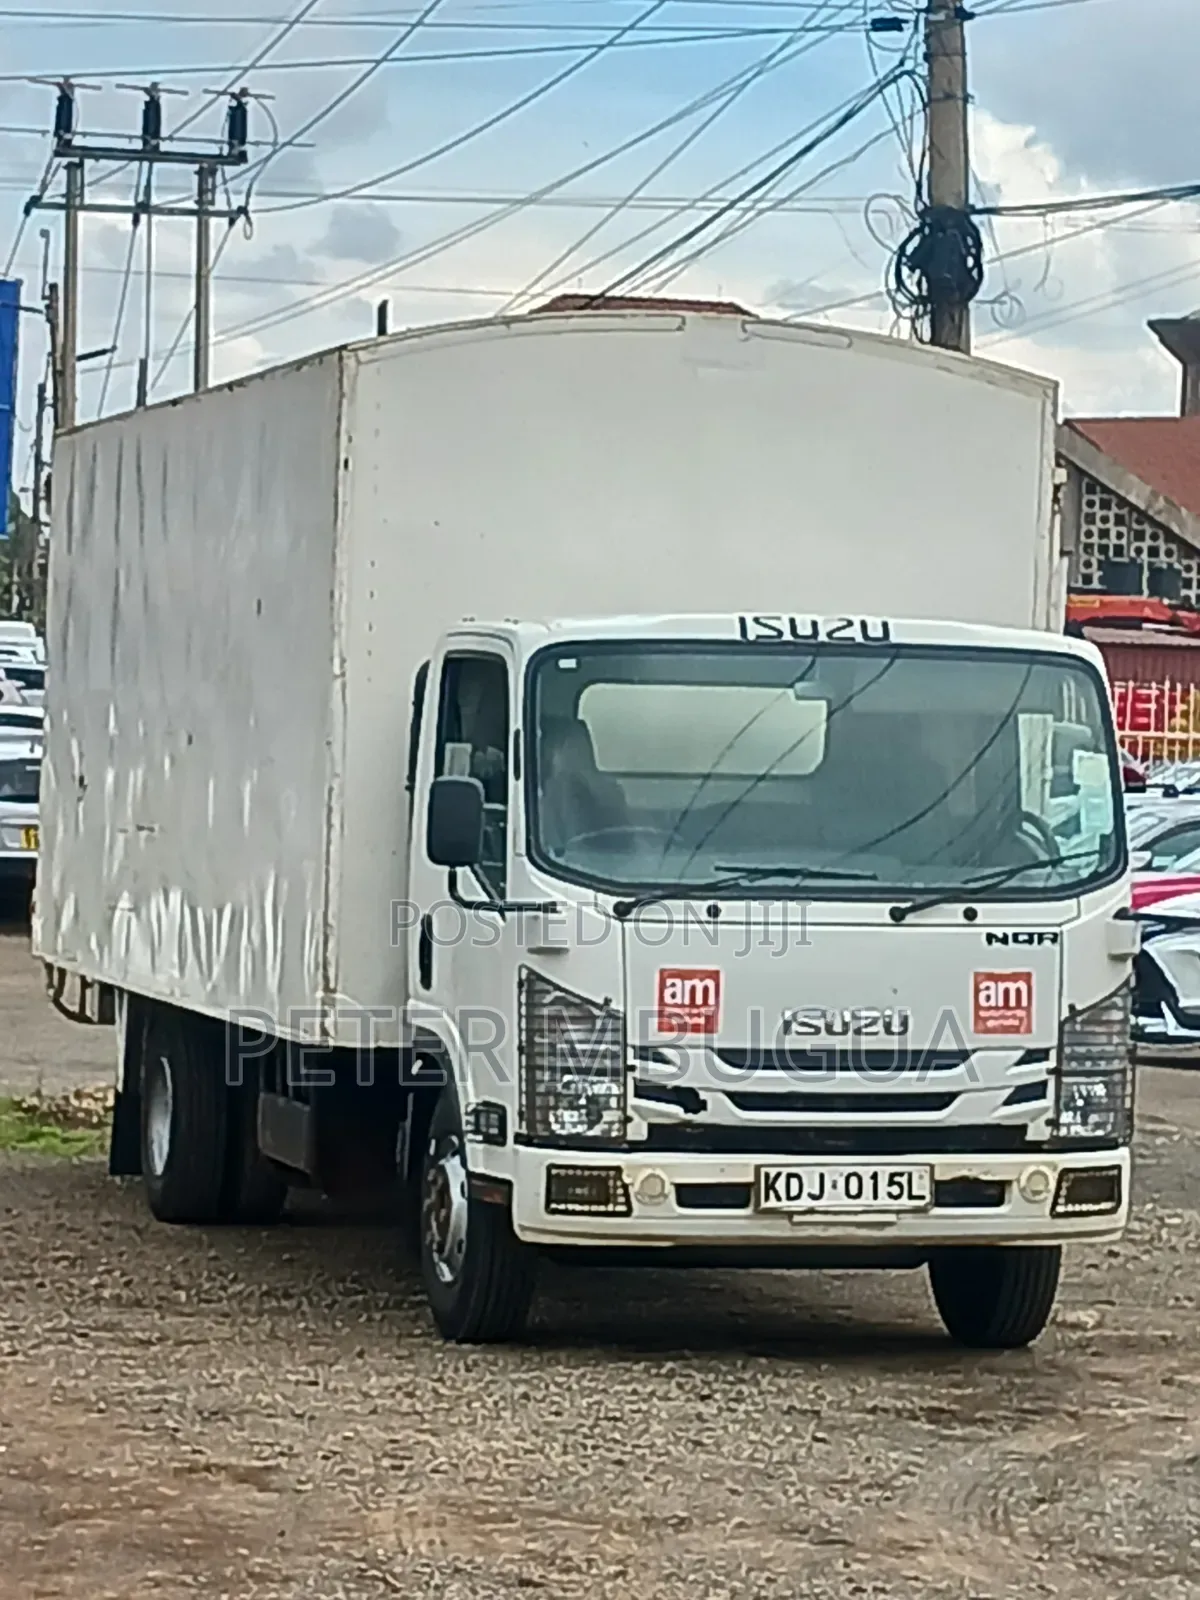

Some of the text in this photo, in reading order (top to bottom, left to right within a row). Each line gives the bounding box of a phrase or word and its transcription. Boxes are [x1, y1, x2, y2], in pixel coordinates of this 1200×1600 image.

[738, 616, 891, 643] ISUZU
[986, 932, 1059, 946] NQR
[664, 978, 716, 1006] am
[978, 980, 1028, 1008] am
[782, 1009, 910, 1036] ISUZU
[764, 1171, 927, 1202] KDJ 015L
